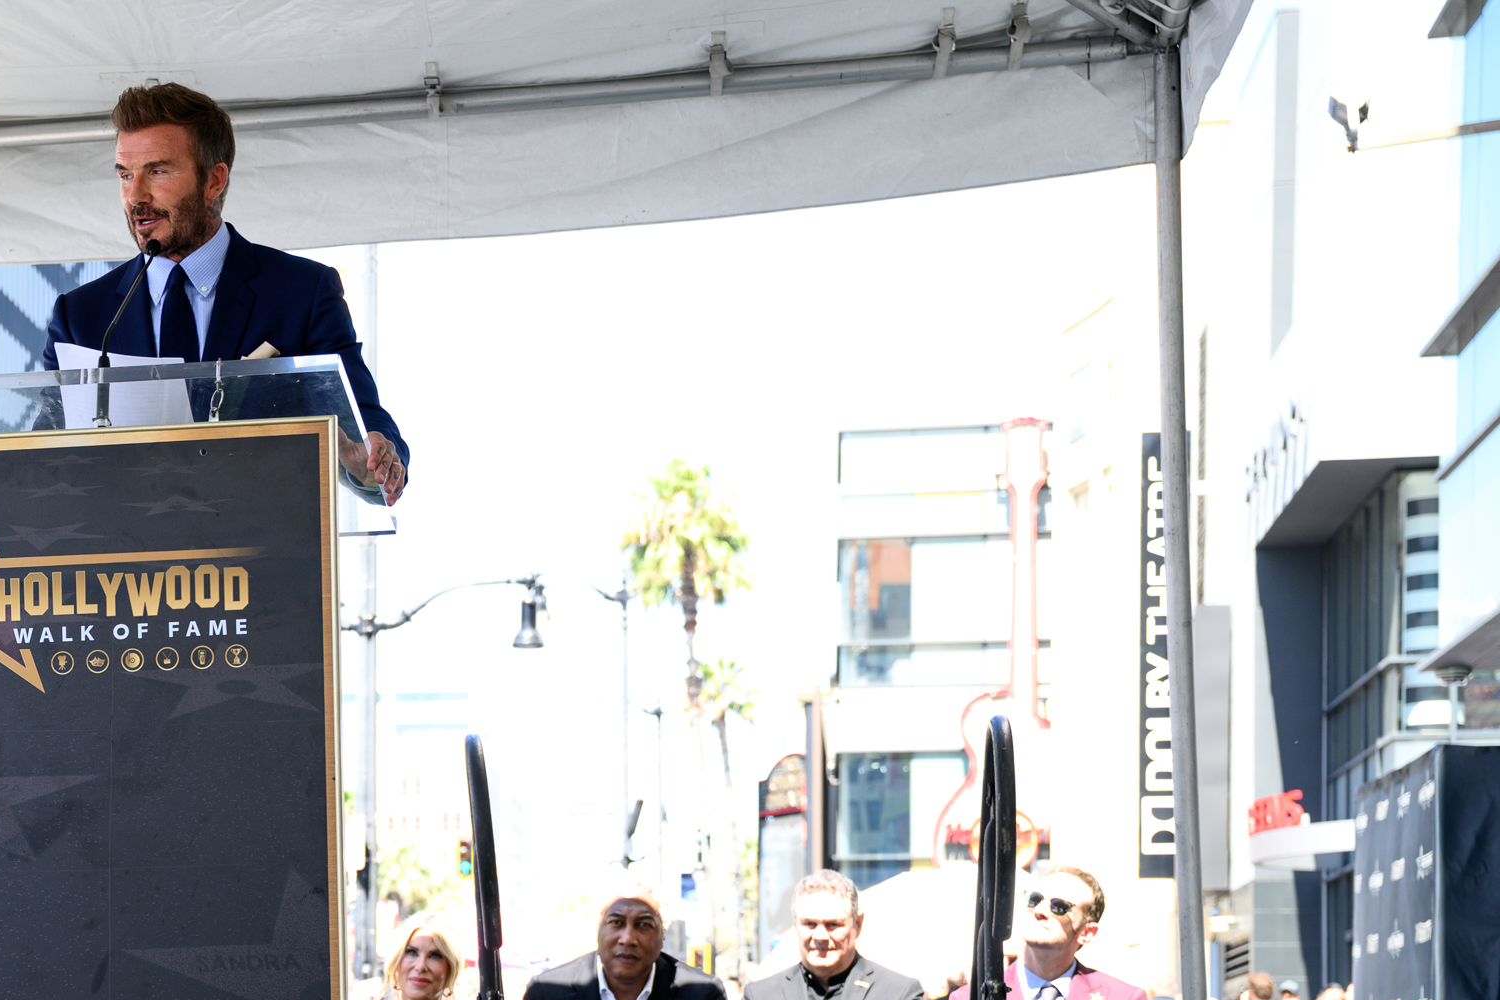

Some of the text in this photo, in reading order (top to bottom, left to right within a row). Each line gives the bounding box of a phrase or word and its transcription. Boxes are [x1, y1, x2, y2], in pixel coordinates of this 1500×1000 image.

[13, 618, 248, 644] WALK OF FAME
[195, 953, 301, 973] SANDRA
